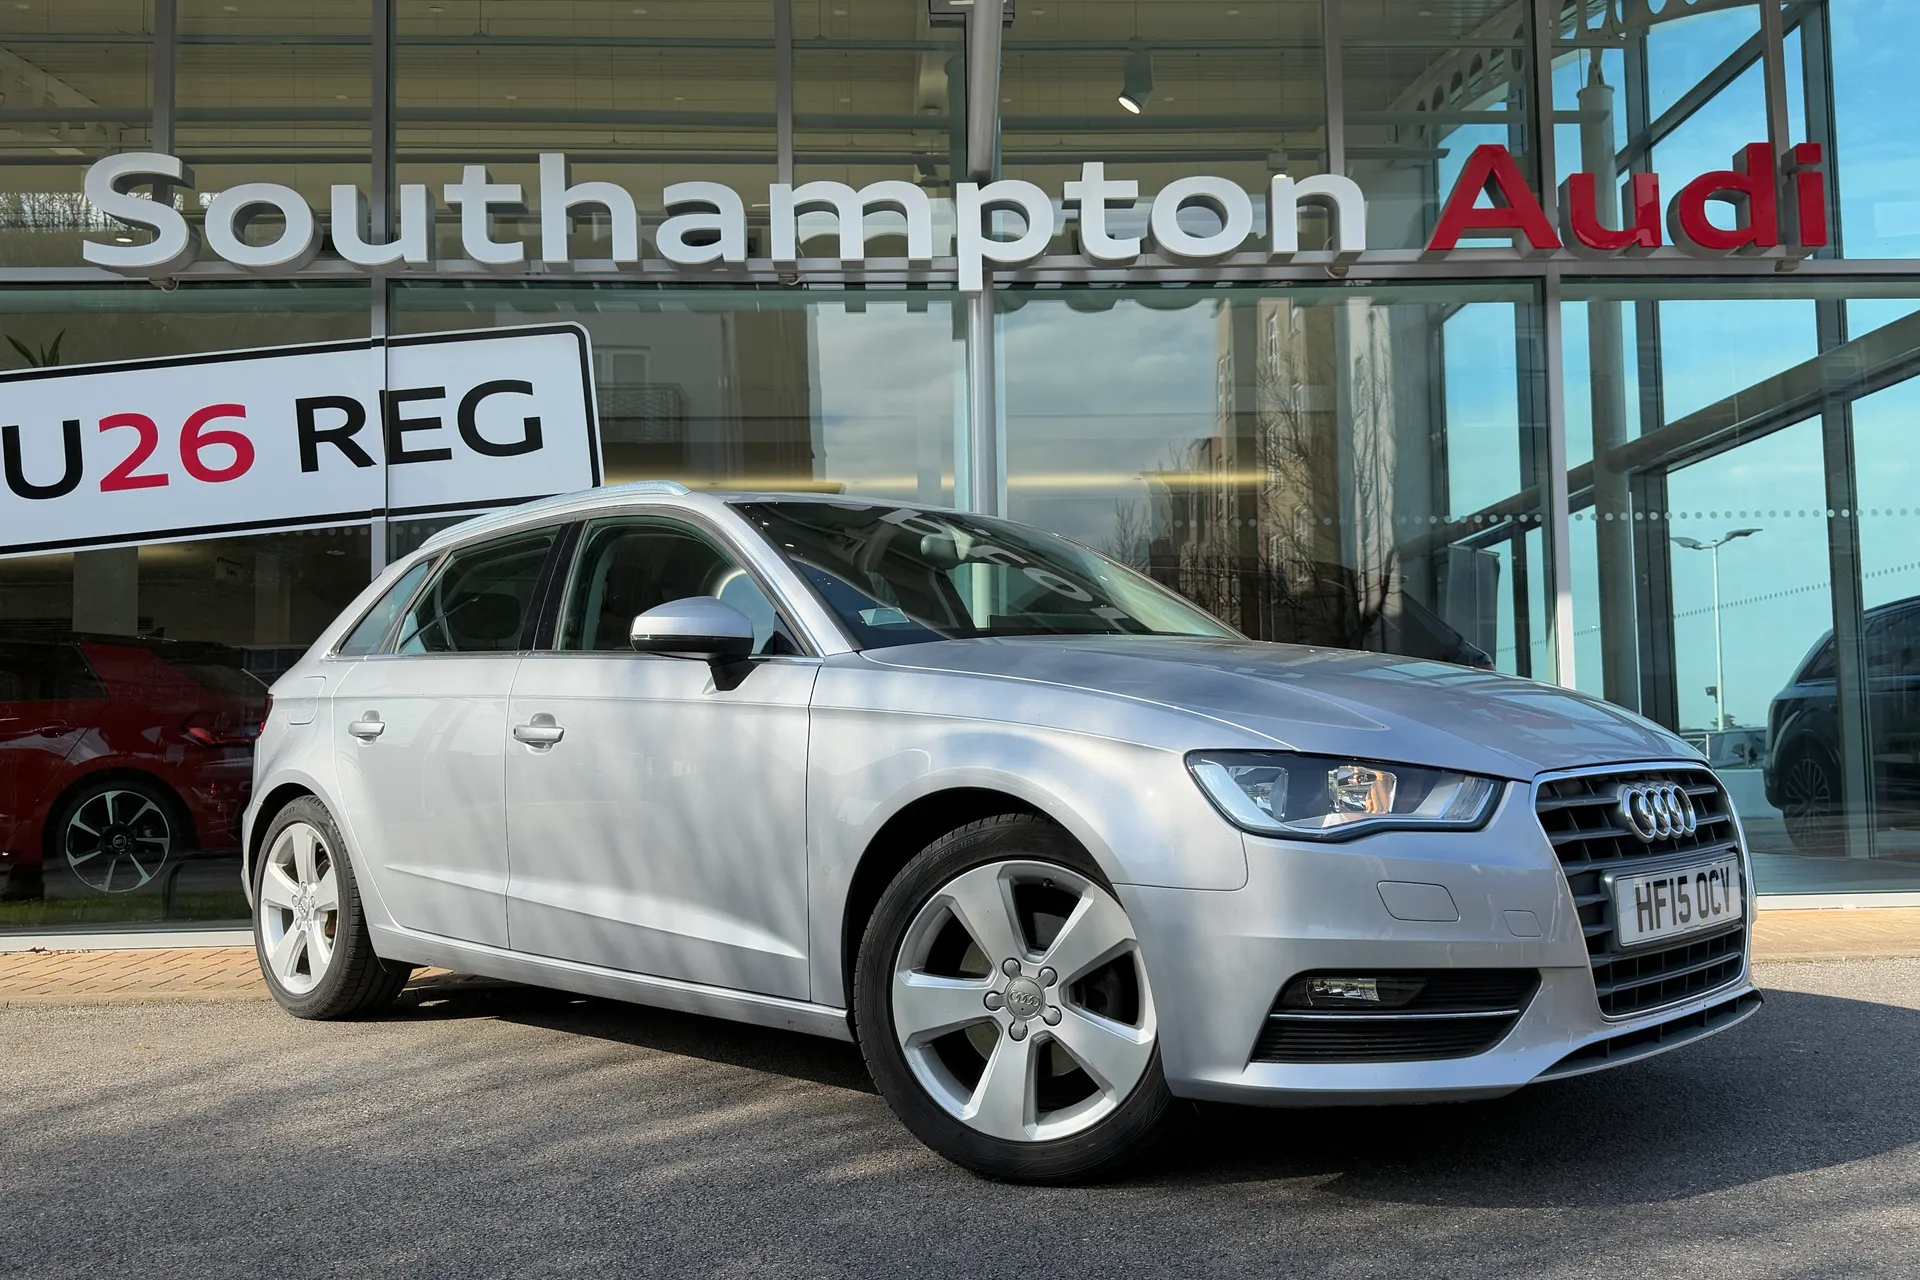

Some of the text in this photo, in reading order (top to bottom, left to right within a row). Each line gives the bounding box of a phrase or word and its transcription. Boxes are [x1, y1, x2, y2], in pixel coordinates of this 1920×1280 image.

[83, 142, 1827, 292] Southampton Audi
[295, 379, 544, 473] REG
[1635, 866, 1730, 933] HF15 OCV
